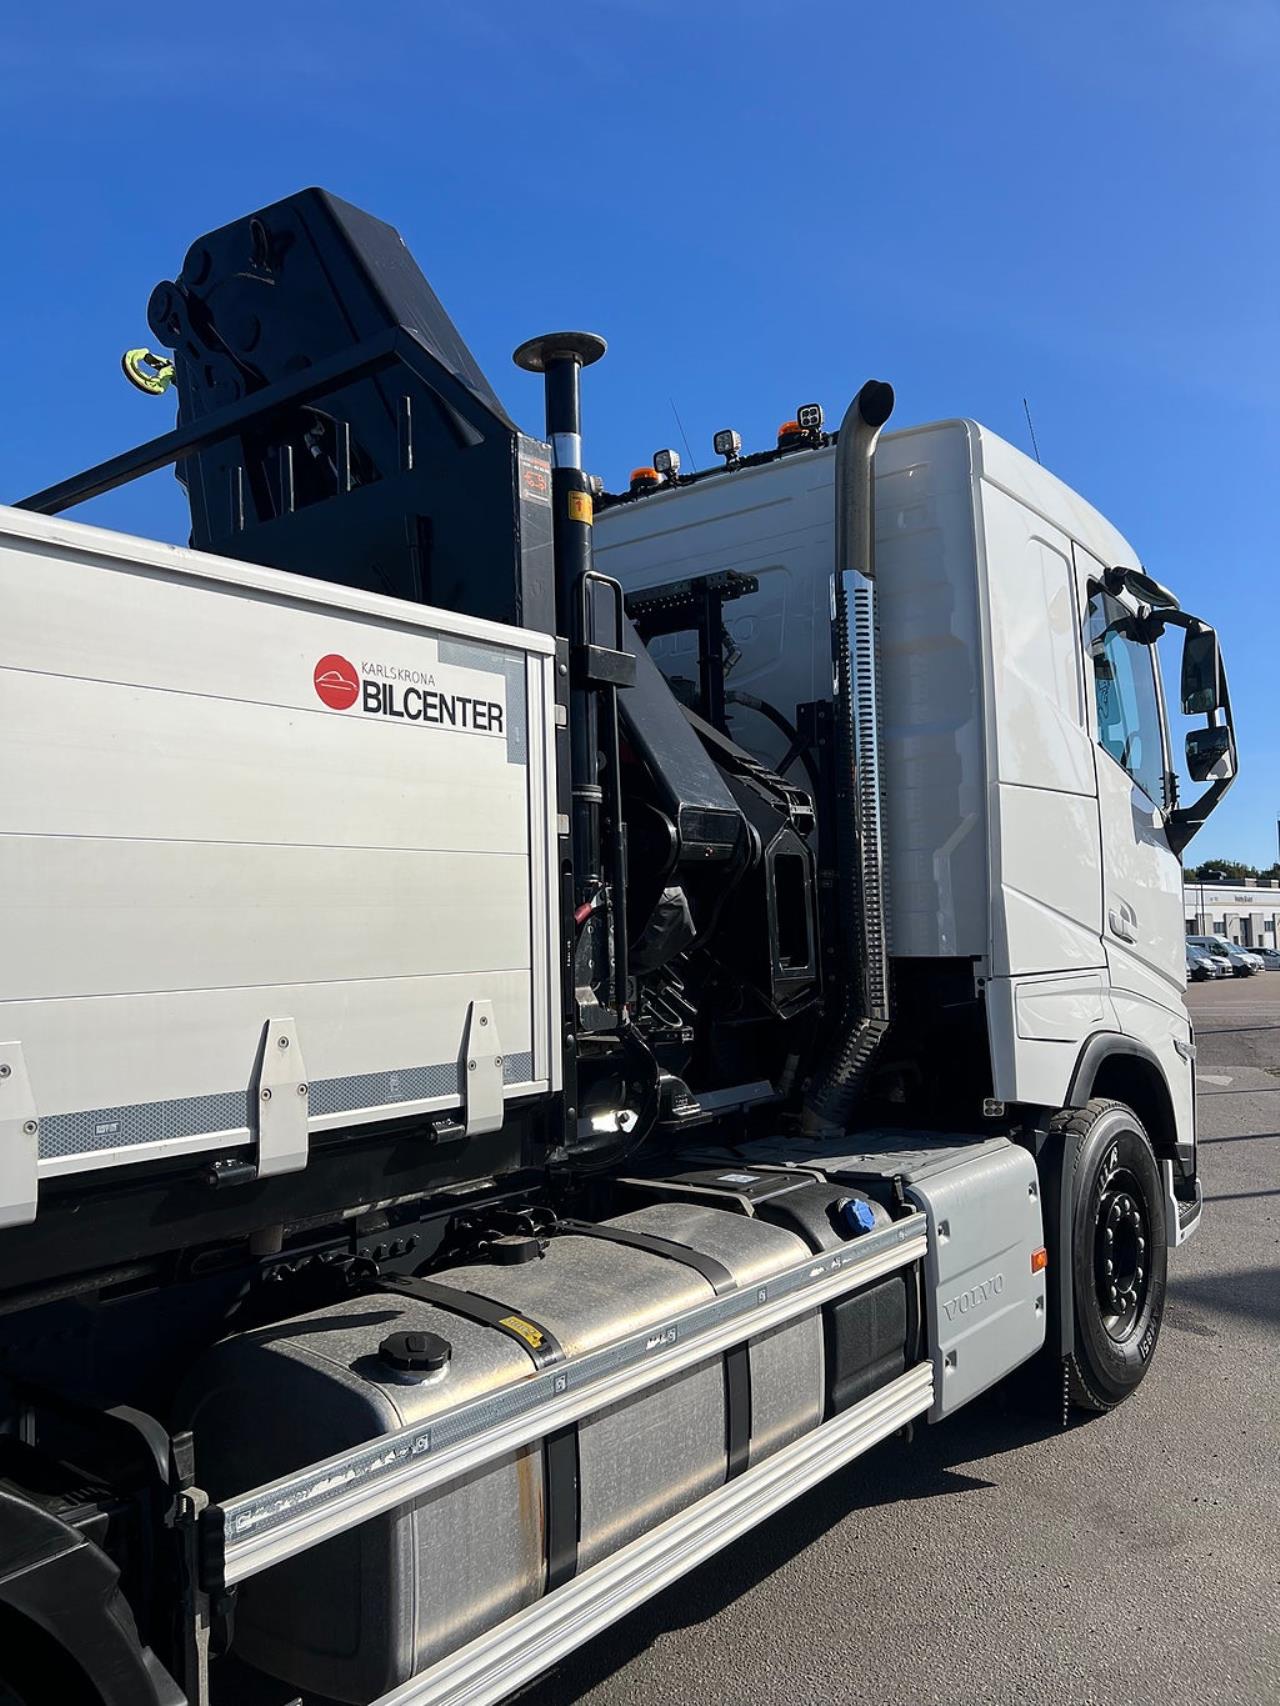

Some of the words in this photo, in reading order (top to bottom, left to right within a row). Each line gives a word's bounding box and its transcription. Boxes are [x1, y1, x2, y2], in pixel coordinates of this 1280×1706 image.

[361, 661, 435, 687] KARLSKRONA
[363, 680, 503, 733] BILCENTER
[943, 1272, 1003, 1321] VOLVO
